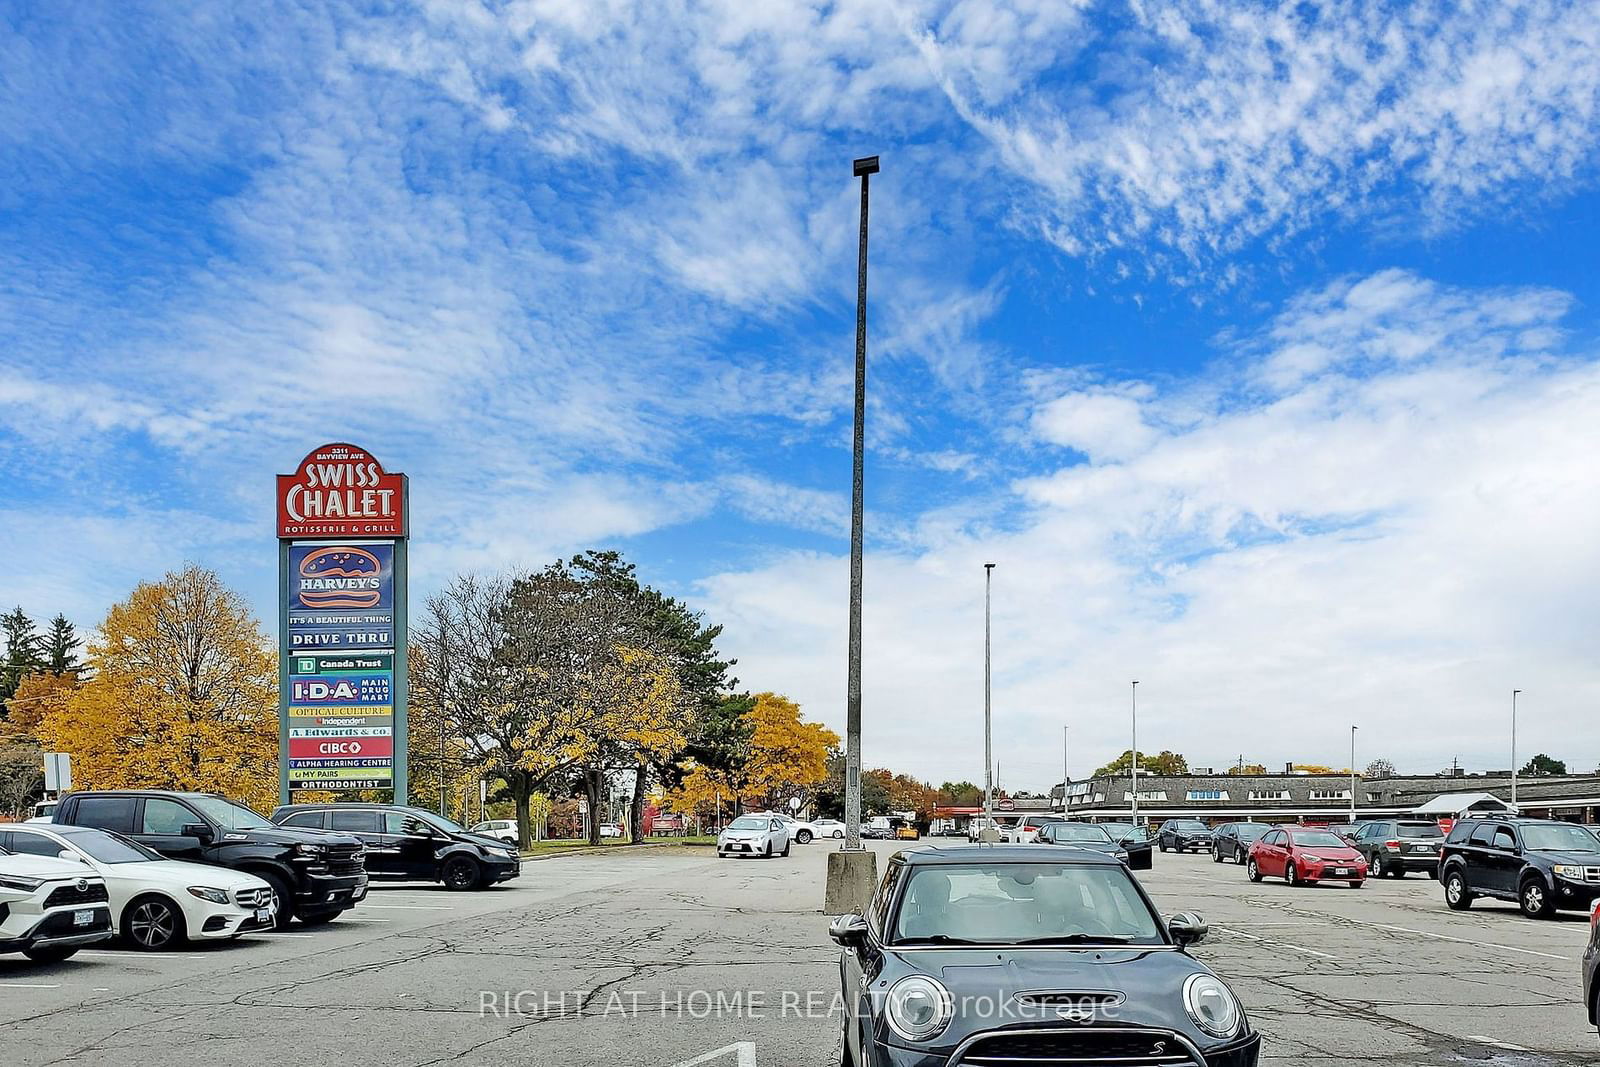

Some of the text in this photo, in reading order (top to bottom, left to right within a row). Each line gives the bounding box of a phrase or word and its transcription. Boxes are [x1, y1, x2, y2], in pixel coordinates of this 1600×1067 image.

[305, 463, 380, 488] SWISS
[286, 484, 395, 524] CHALET
[300, 578, 380, 590] HARVEY'S
[316, 616, 362, 624] BEAUTIFUL
[293, 633, 388, 644] DRIVE THRU
[300, 660, 313, 670] TD
[320, 660, 354, 668] Canada
[362, 686, 389, 694] DRUG
[296, 707, 385, 716] OPTICAL CULTURE
[322, 718, 366, 726] Independent
[320, 743, 348, 754] CIBC
[1149, 1041, 1166, 1055] S
